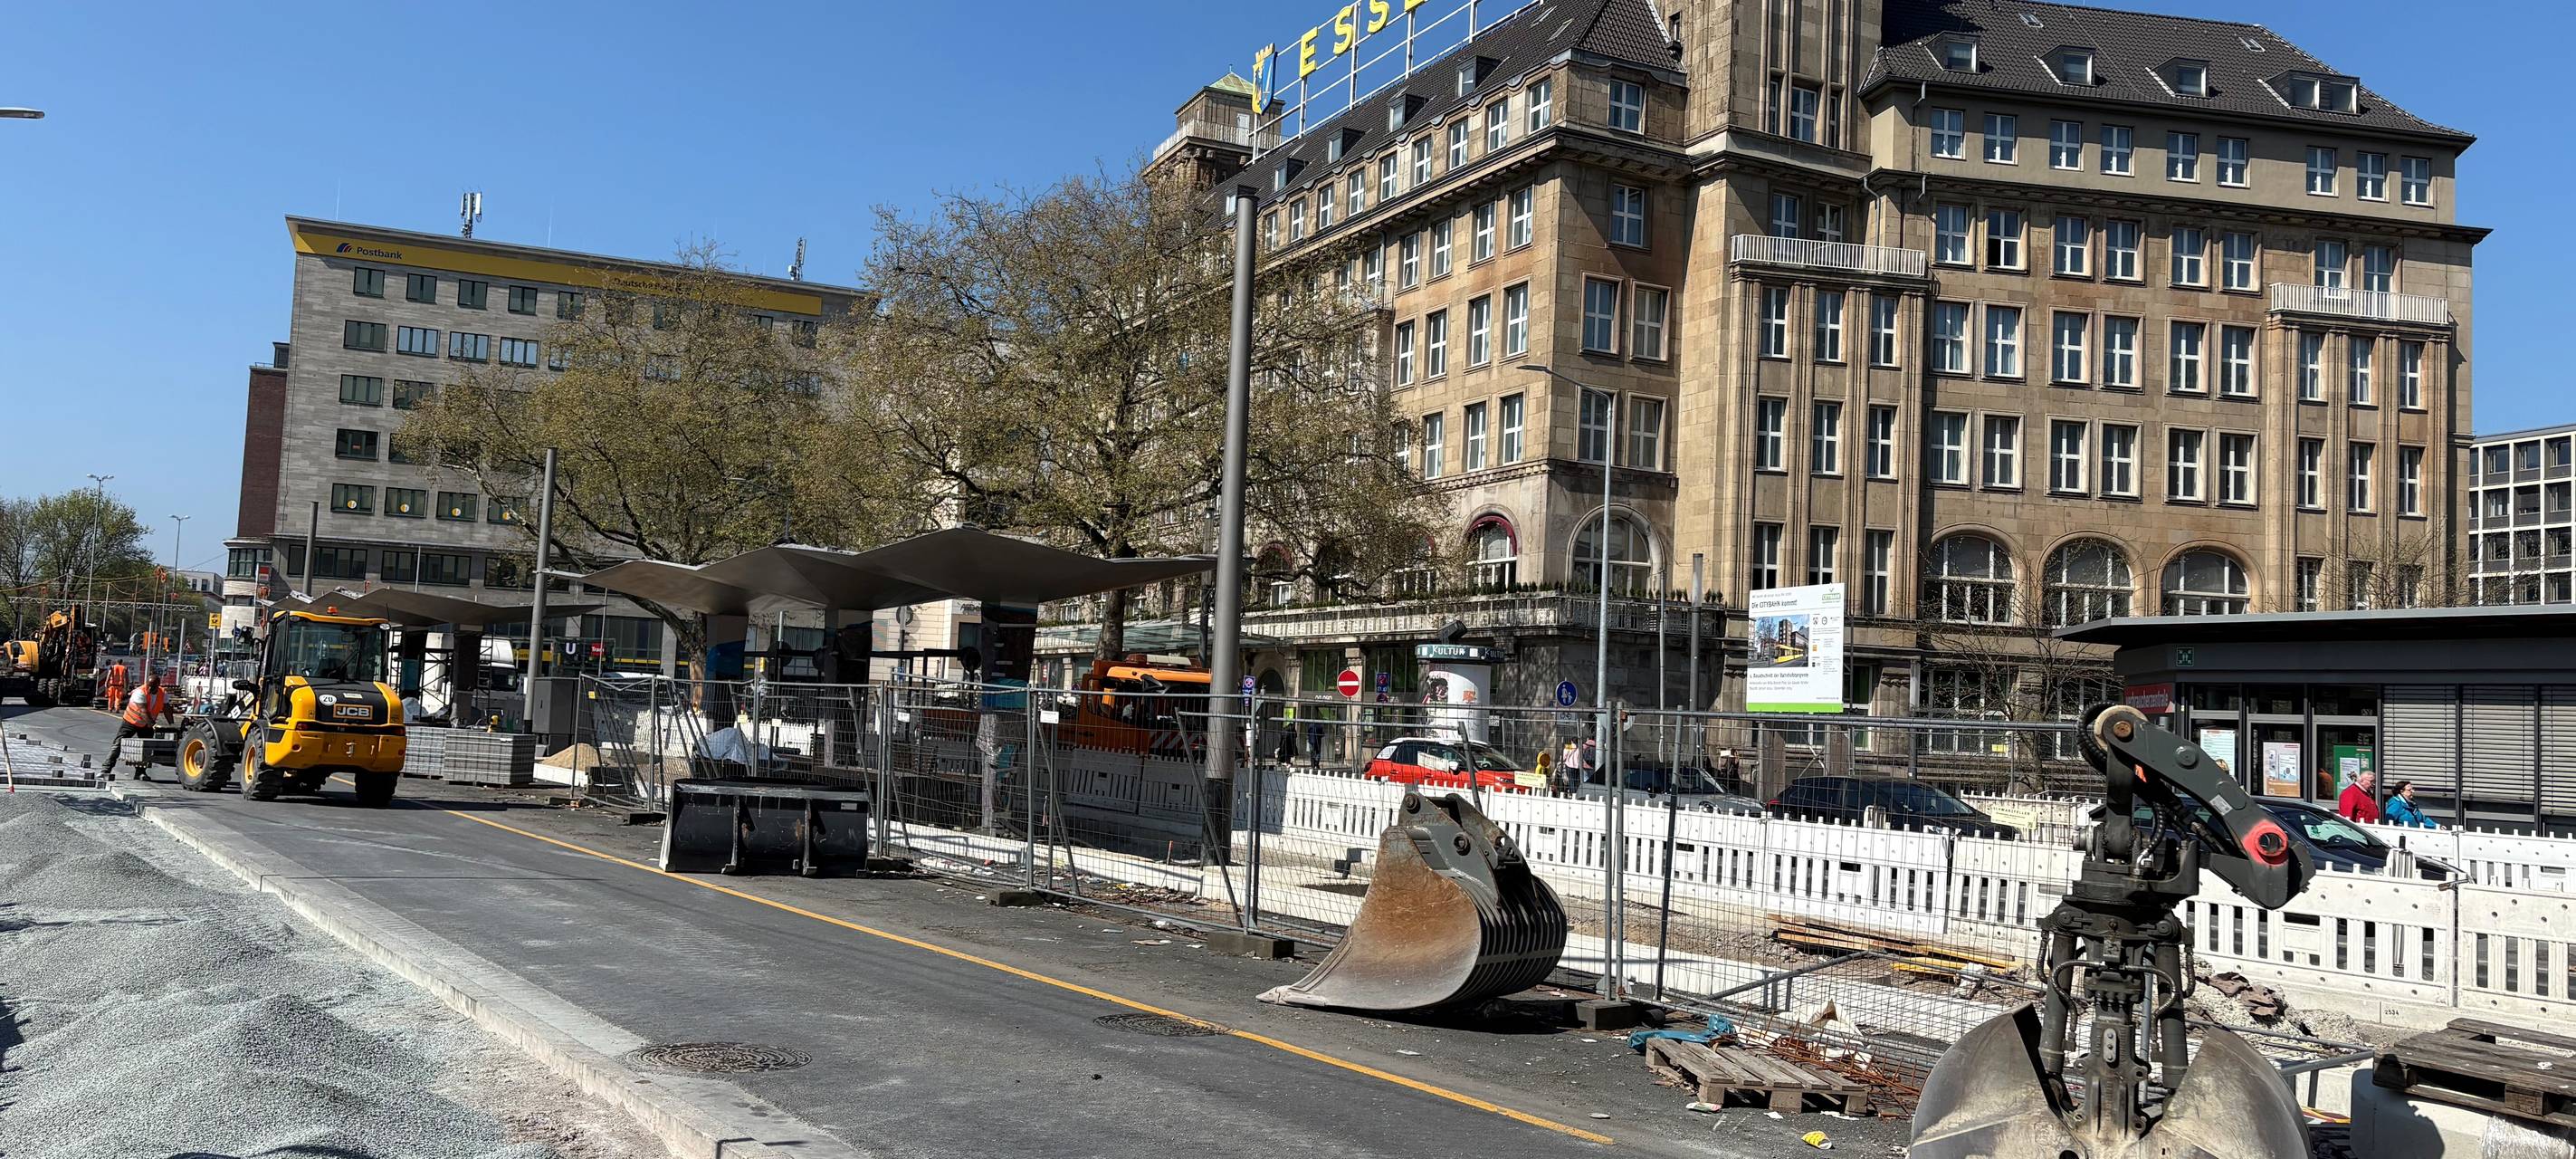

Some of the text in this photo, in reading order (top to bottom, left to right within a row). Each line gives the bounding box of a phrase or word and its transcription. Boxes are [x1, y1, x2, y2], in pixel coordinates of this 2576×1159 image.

[1299, 0, 1426, 78] ESS
[357, 246, 403, 260] Postbank
[1760, 600, 1780, 608] CITYBAHN
[566, 642, 577, 655] U
[1428, 644, 1465, 658] KULTUR
[337, 706, 370, 717] JCB
